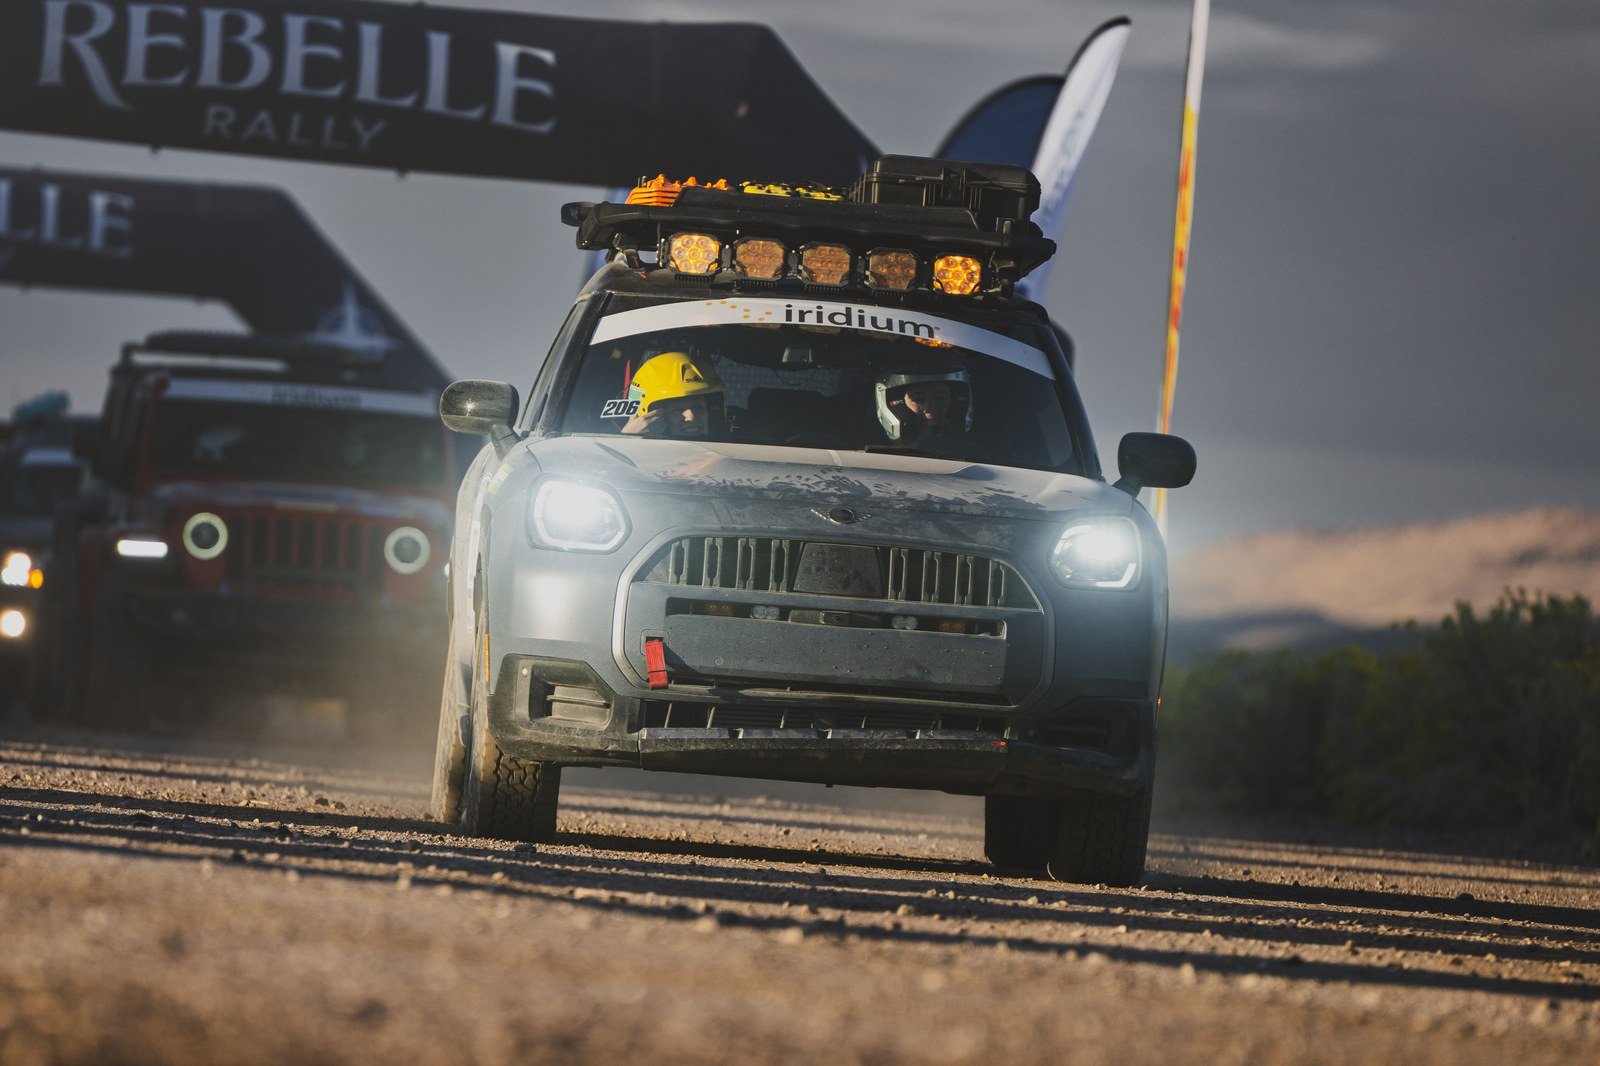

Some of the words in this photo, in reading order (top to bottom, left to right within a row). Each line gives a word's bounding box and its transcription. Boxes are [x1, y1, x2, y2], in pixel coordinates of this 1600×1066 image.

[38, 0, 558, 135] REBELLE
[204, 104, 387, 152] RALLY
[785, 303, 935, 339] iridium
[602, 400, 641, 416] 206
